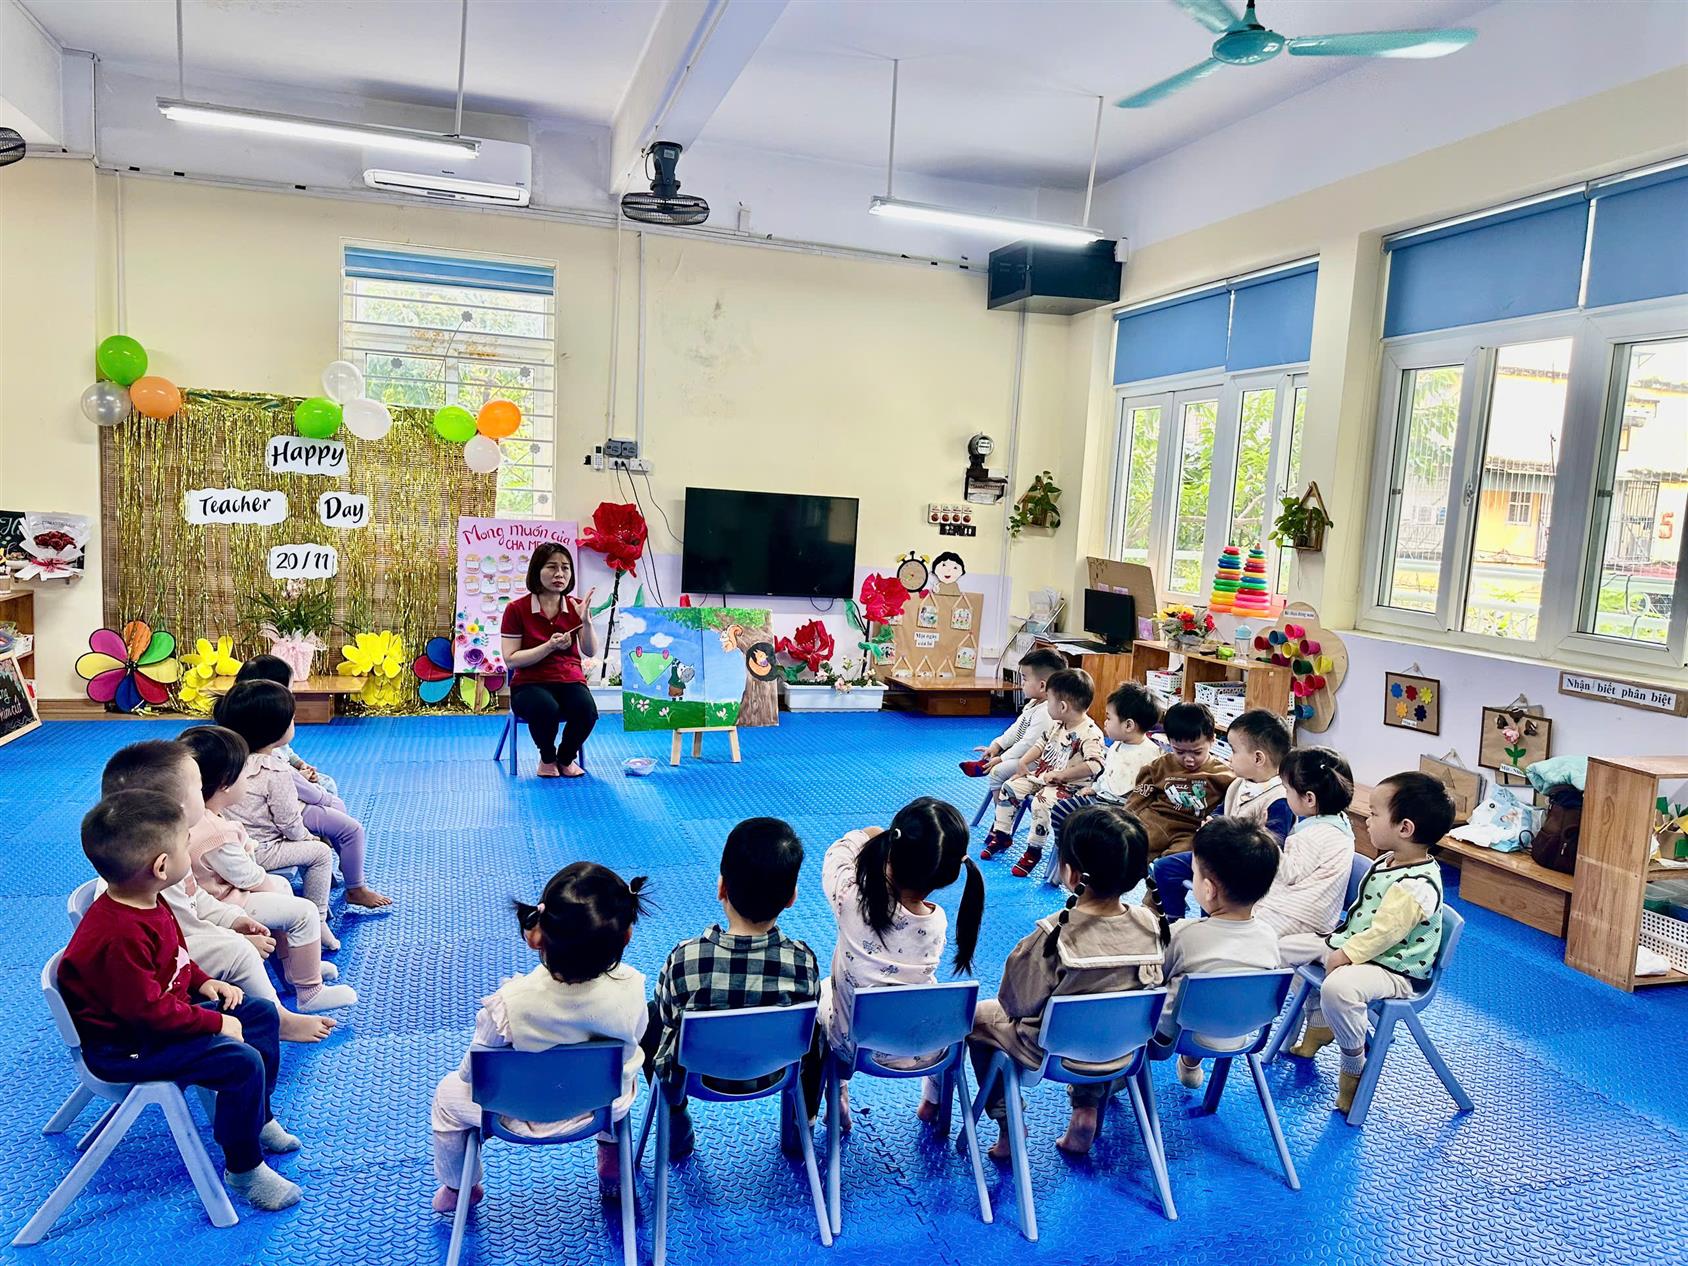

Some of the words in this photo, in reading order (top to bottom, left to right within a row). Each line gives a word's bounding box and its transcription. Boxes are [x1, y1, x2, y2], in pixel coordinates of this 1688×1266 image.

[271, 441, 345, 467] Happy
[199, 495, 271, 516] Teacher
[324, 496, 364, 524] Day
[506, 540, 525, 551] CHA
[276, 551, 329, 571] 20/11
[1567, 678, 1591, 692] Nhận
[1597, 681, 1616, 695] biết
[1621, 688, 1646, 701] phân
[1650, 692, 1673, 707] biệt
